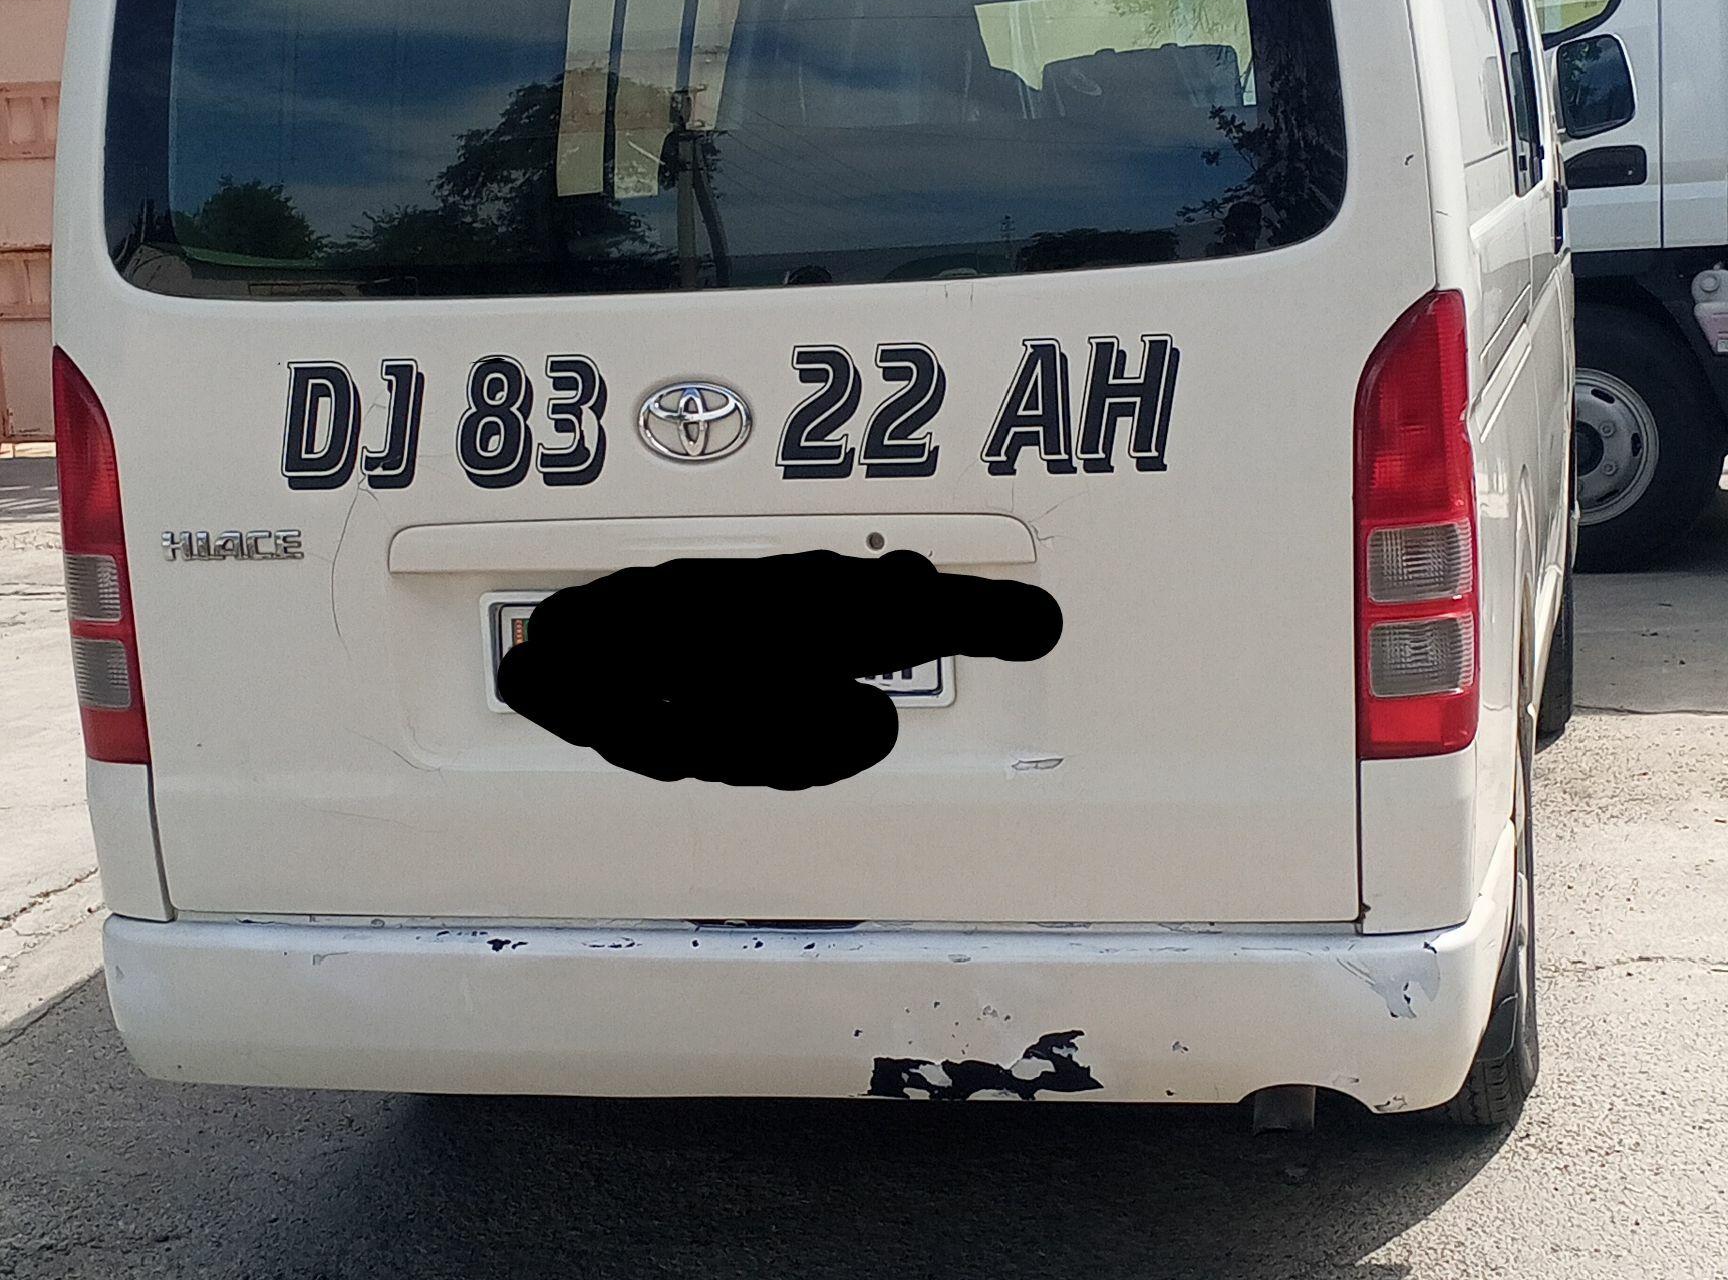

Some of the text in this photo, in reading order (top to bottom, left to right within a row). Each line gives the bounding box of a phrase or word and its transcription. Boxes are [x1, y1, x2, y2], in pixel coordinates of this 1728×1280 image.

[281, 333, 1181, 490] DJ 83 22 AH
[160, 528, 305, 562] HIACE
